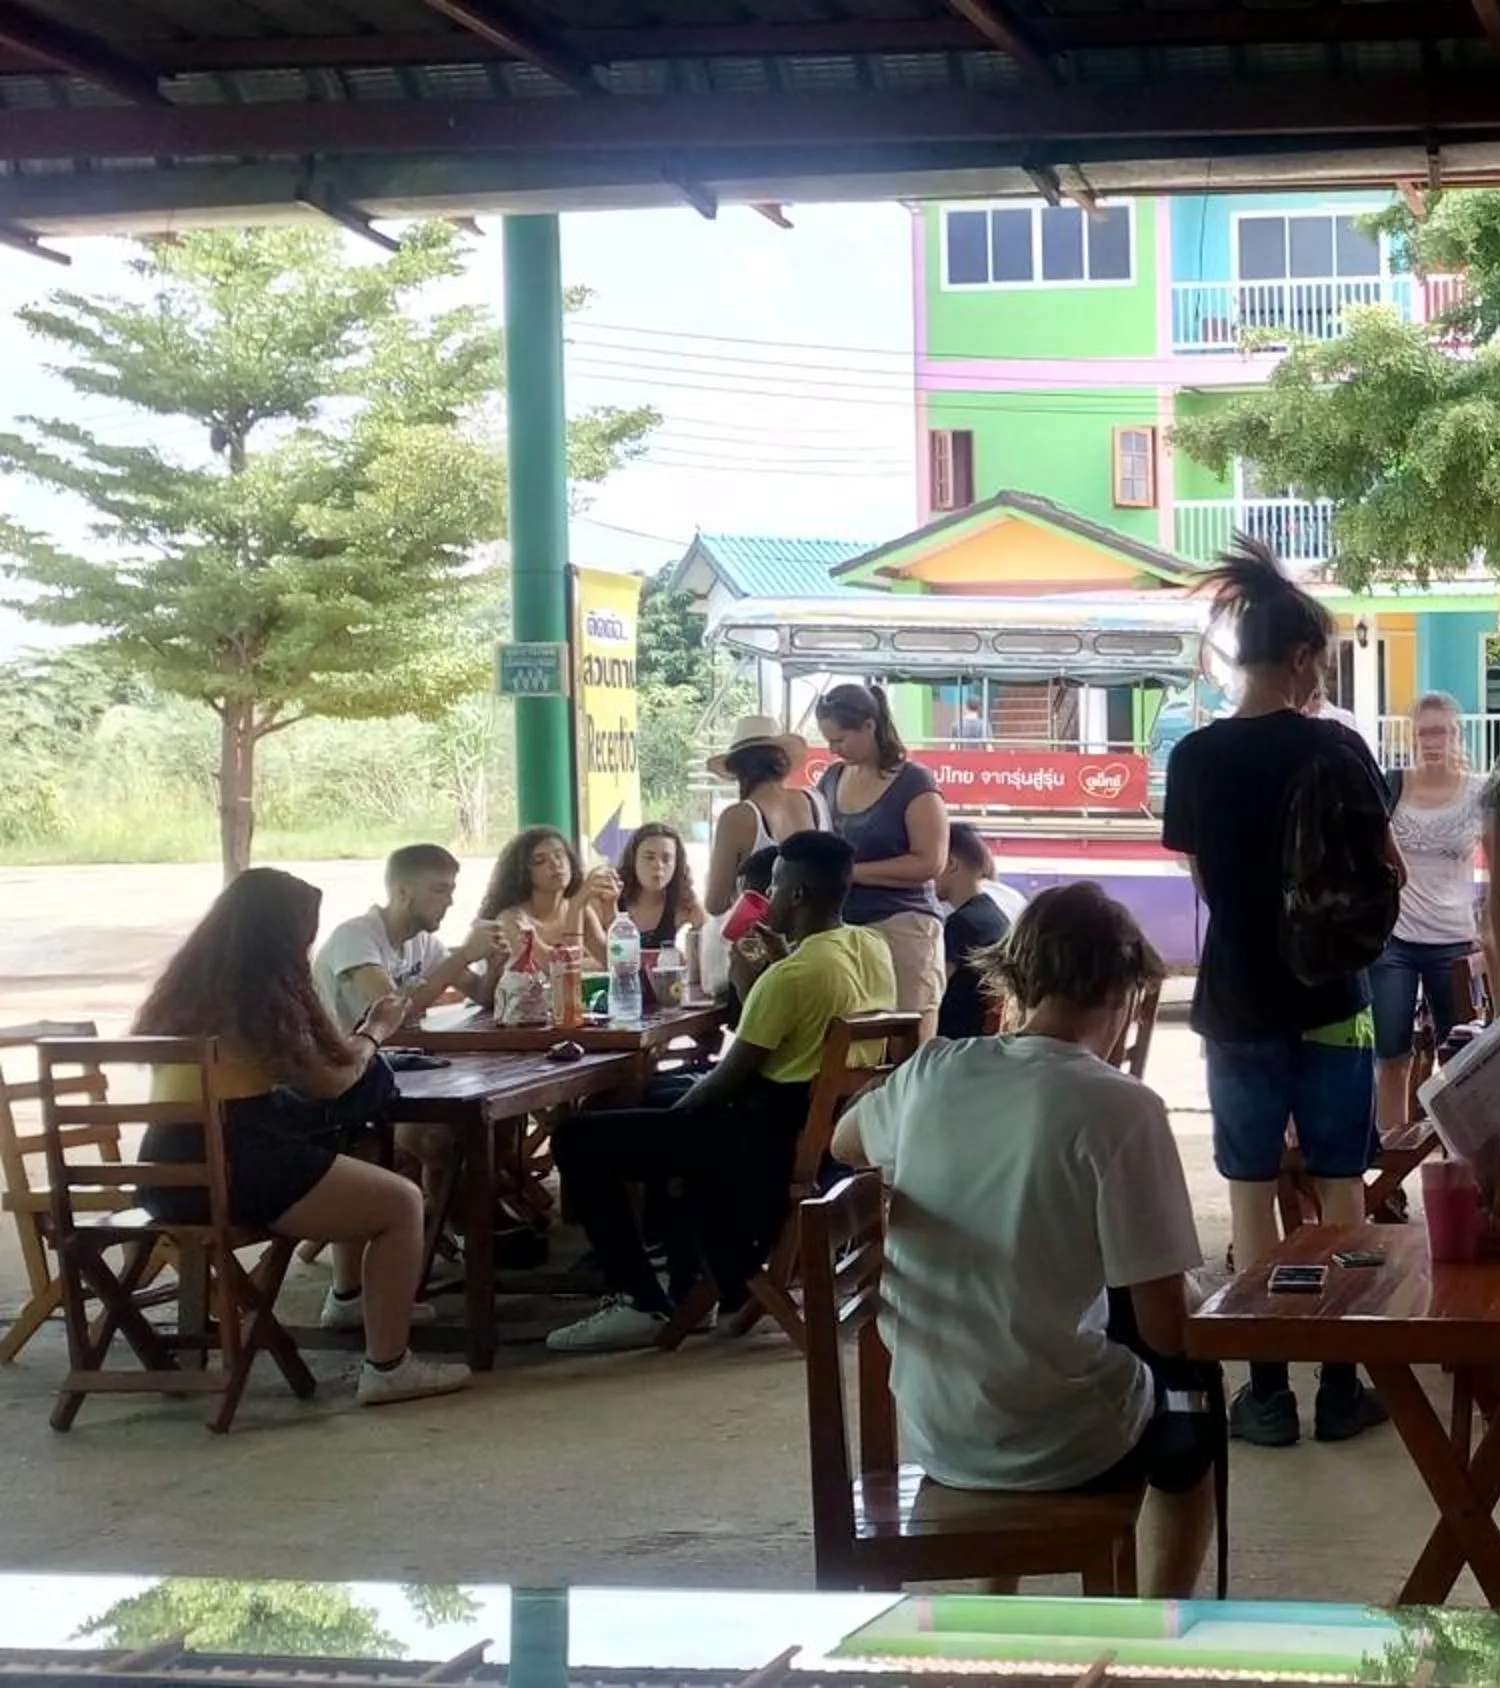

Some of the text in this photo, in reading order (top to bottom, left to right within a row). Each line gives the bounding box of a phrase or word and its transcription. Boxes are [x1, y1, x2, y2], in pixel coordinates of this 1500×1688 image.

[587, 714, 638, 787] Receptio
[981, 766, 1065, 791] จากรุ่นสู่รุ่น
